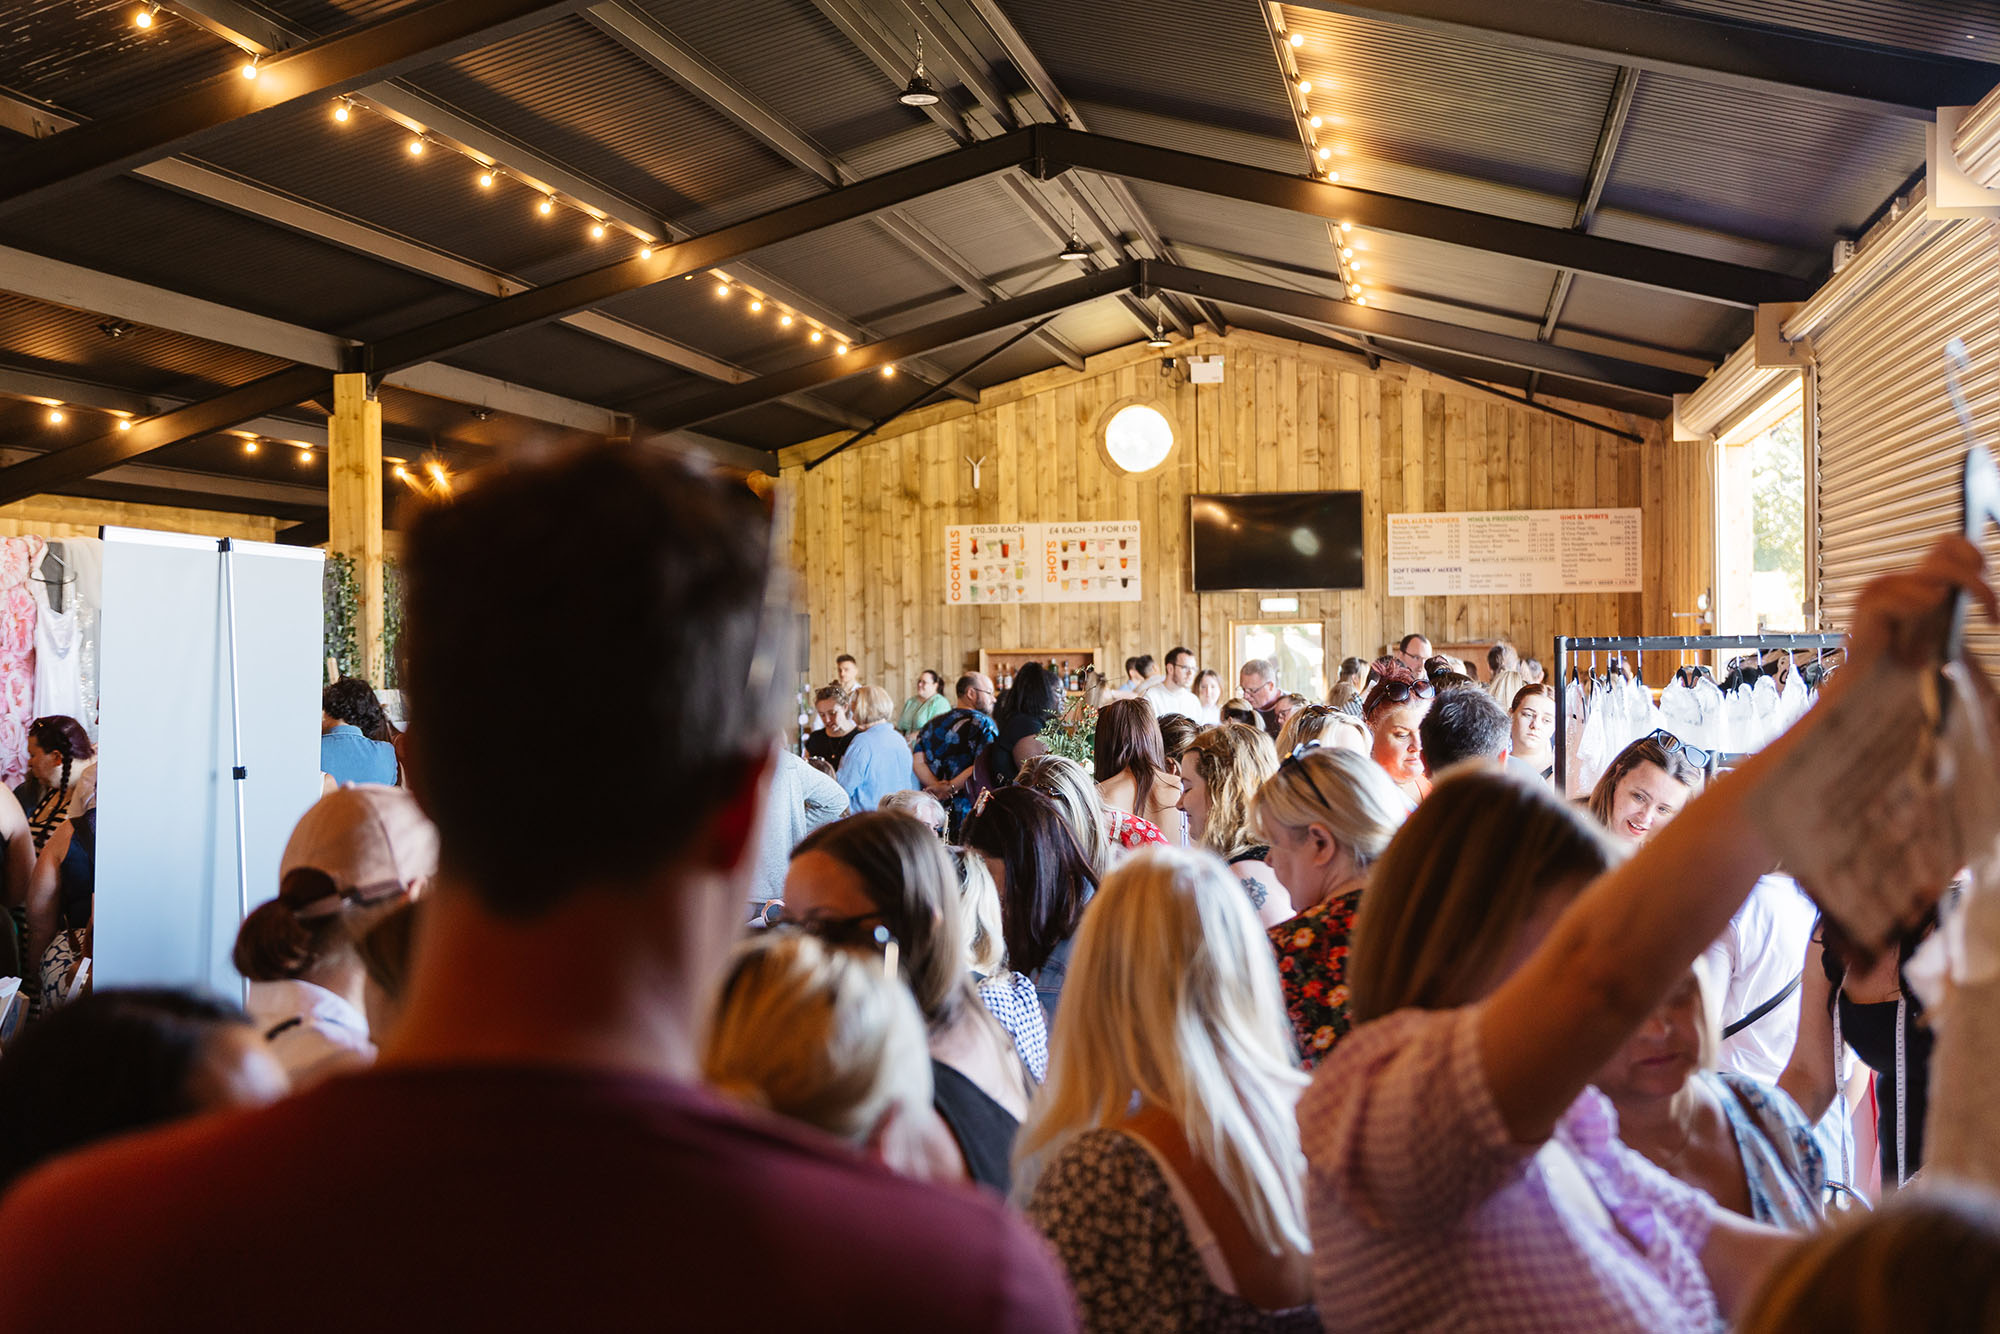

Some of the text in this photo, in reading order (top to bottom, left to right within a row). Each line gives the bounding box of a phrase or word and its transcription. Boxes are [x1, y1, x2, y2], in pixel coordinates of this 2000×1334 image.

[970, 525, 1024, 534] £10.50 EACH
[1061, 526, 1086, 534] EACH
[1101, 525, 1119, 533] FOR
[1122, 525, 1138, 533] £10
[950, 530, 961, 601] COCKTAILS
[1046, 540, 1057, 583] SHOTS
